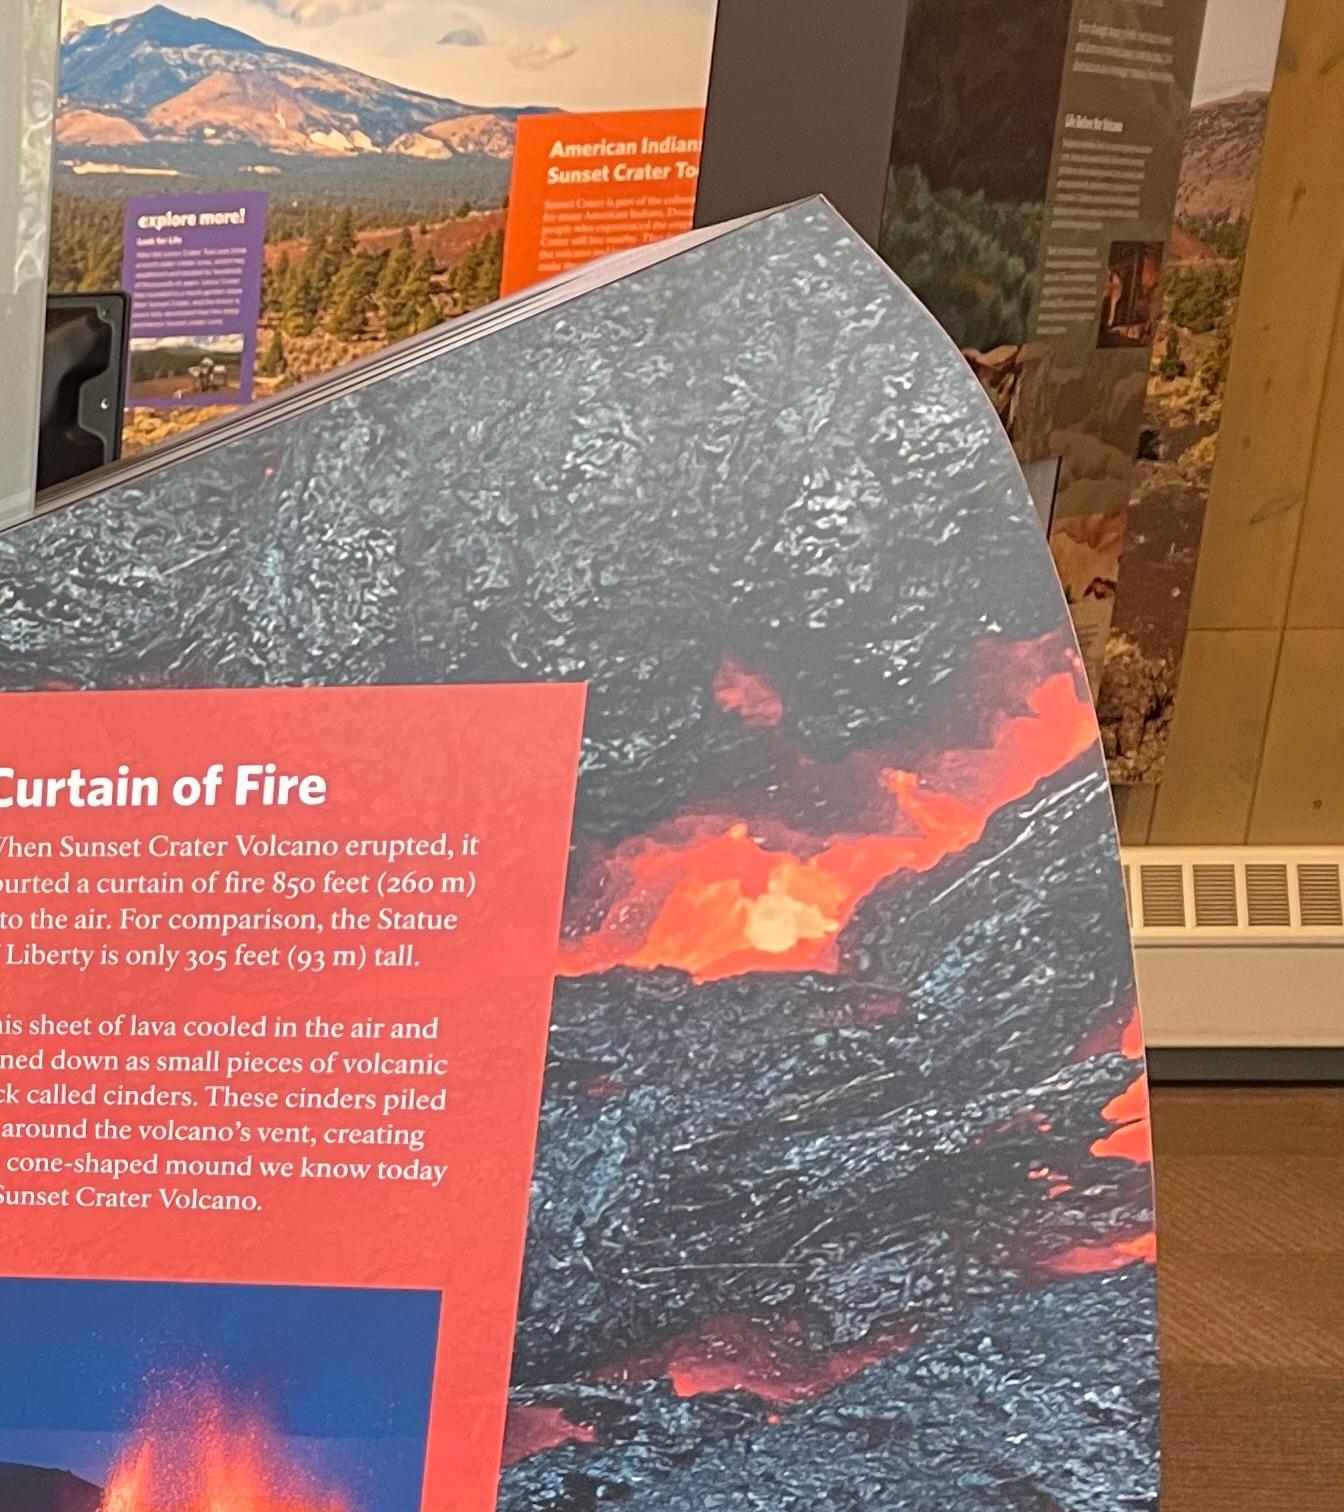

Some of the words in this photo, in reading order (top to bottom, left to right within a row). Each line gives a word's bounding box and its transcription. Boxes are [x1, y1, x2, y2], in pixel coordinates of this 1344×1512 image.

[549, 139, 637, 159] American
[546, 165, 610, 185] Sunset
[613, 162, 672, 182] Crater
[137, 211, 197, 231] explore
[199, 207, 246, 226] more!
[173, 764, 223, 805] of
[236, 763, 326, 805] Fire
[60, 836, 141, 858] Sunset
[149, 835, 228, 856] Crater
[236, 834, 338, 856] Volcano
[346, 833, 453, 862] erupted,
[463, 834, 479, 855] it
[77, 878, 89, 893] a
[97, 872, 183, 893] curtain
[192, 871, 220, 893] of
[224, 871, 265, 893] fire
[273, 871, 315, 899] 850
[323, 870, 370, 893] feet
[378, 871, 433, 897] (260
[441, 872, 475, 897] m)
[31, 908, 67, 929] the
[75, 909, 111, 929] air.
[120, 908, 162, 929] For
[169, 909, 323, 936] comparison,
[332, 908, 370, 930] the
[378, 908, 457, 930] Statue
[6, 943, 94, 971] Liberty
[101, 944, 118, 965] is
[126, 944, 179, 971] only
[185, 950, 227, 971] 305
[235, 944, 280, 966] feet
[288, 945, 325, 971] (93
[333, 946, 366, 970] m)
[375, 945, 419, 966] tall.
[76, 1186, 152, 1207] Crater
[159, 1188, 261, 1211] Volcano.
